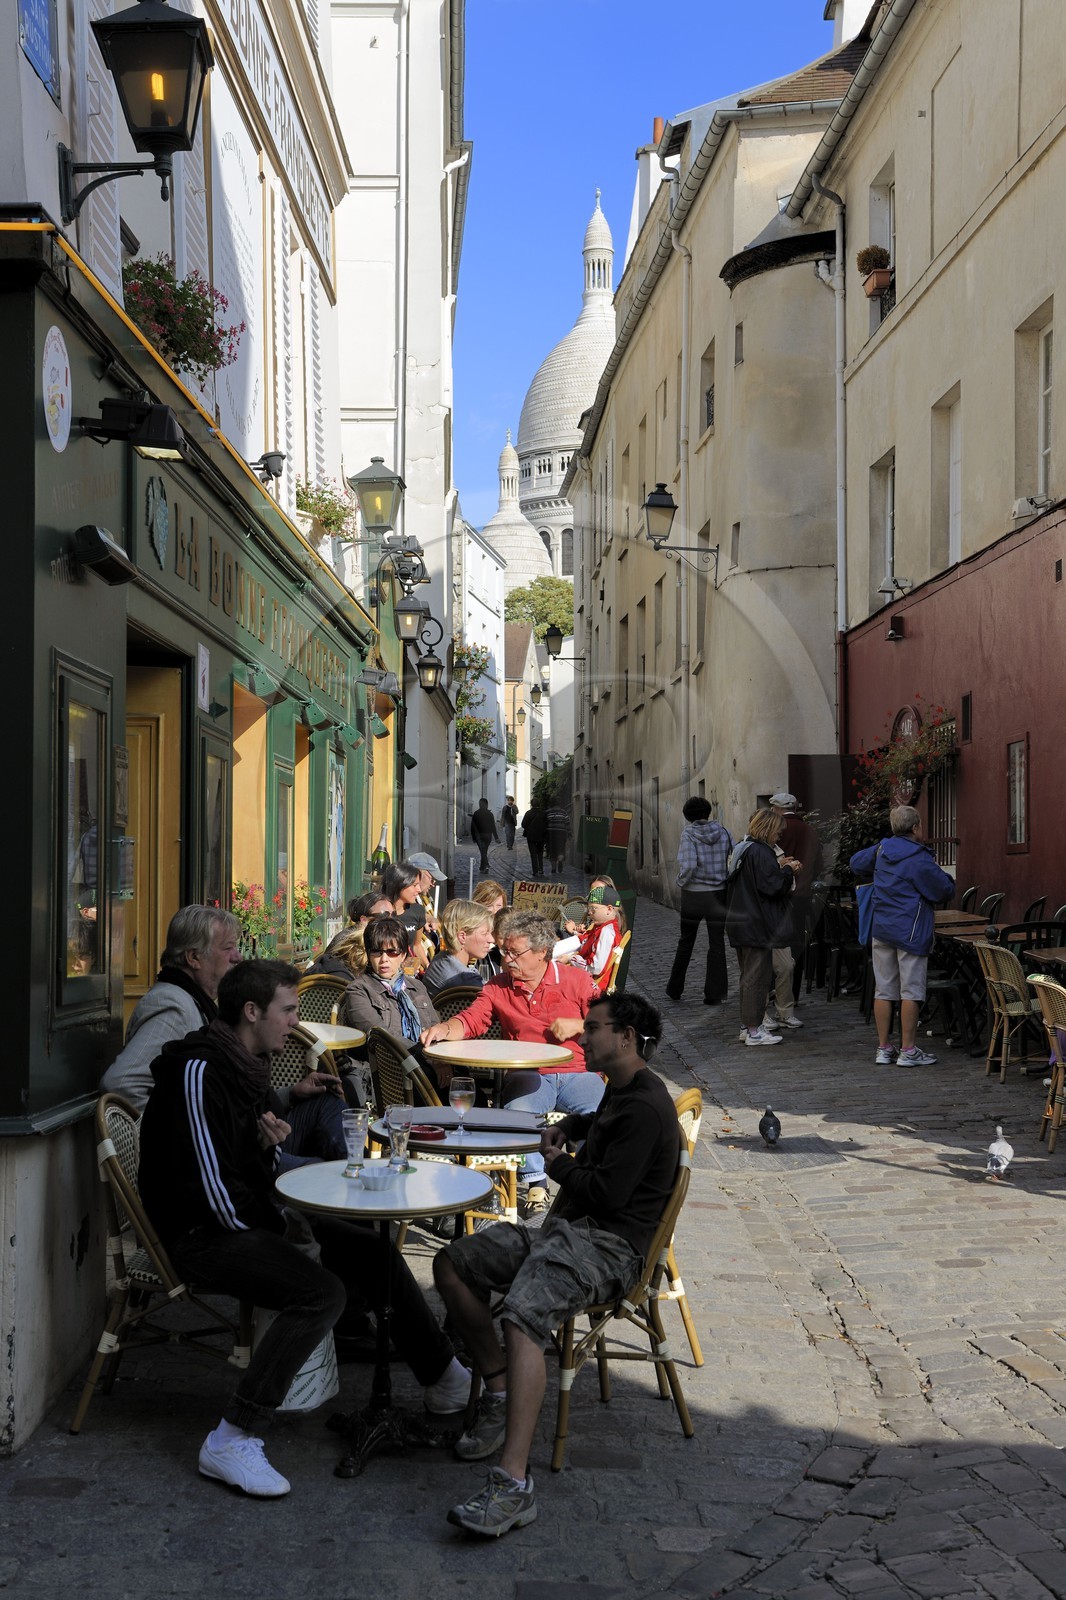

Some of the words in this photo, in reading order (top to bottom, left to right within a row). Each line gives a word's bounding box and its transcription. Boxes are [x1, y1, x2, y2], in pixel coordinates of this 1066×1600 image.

[174, 502, 200, 592] LA
[209, 536, 267, 645] BONNE
[271, 597, 346, 708] FRANQUETTE
